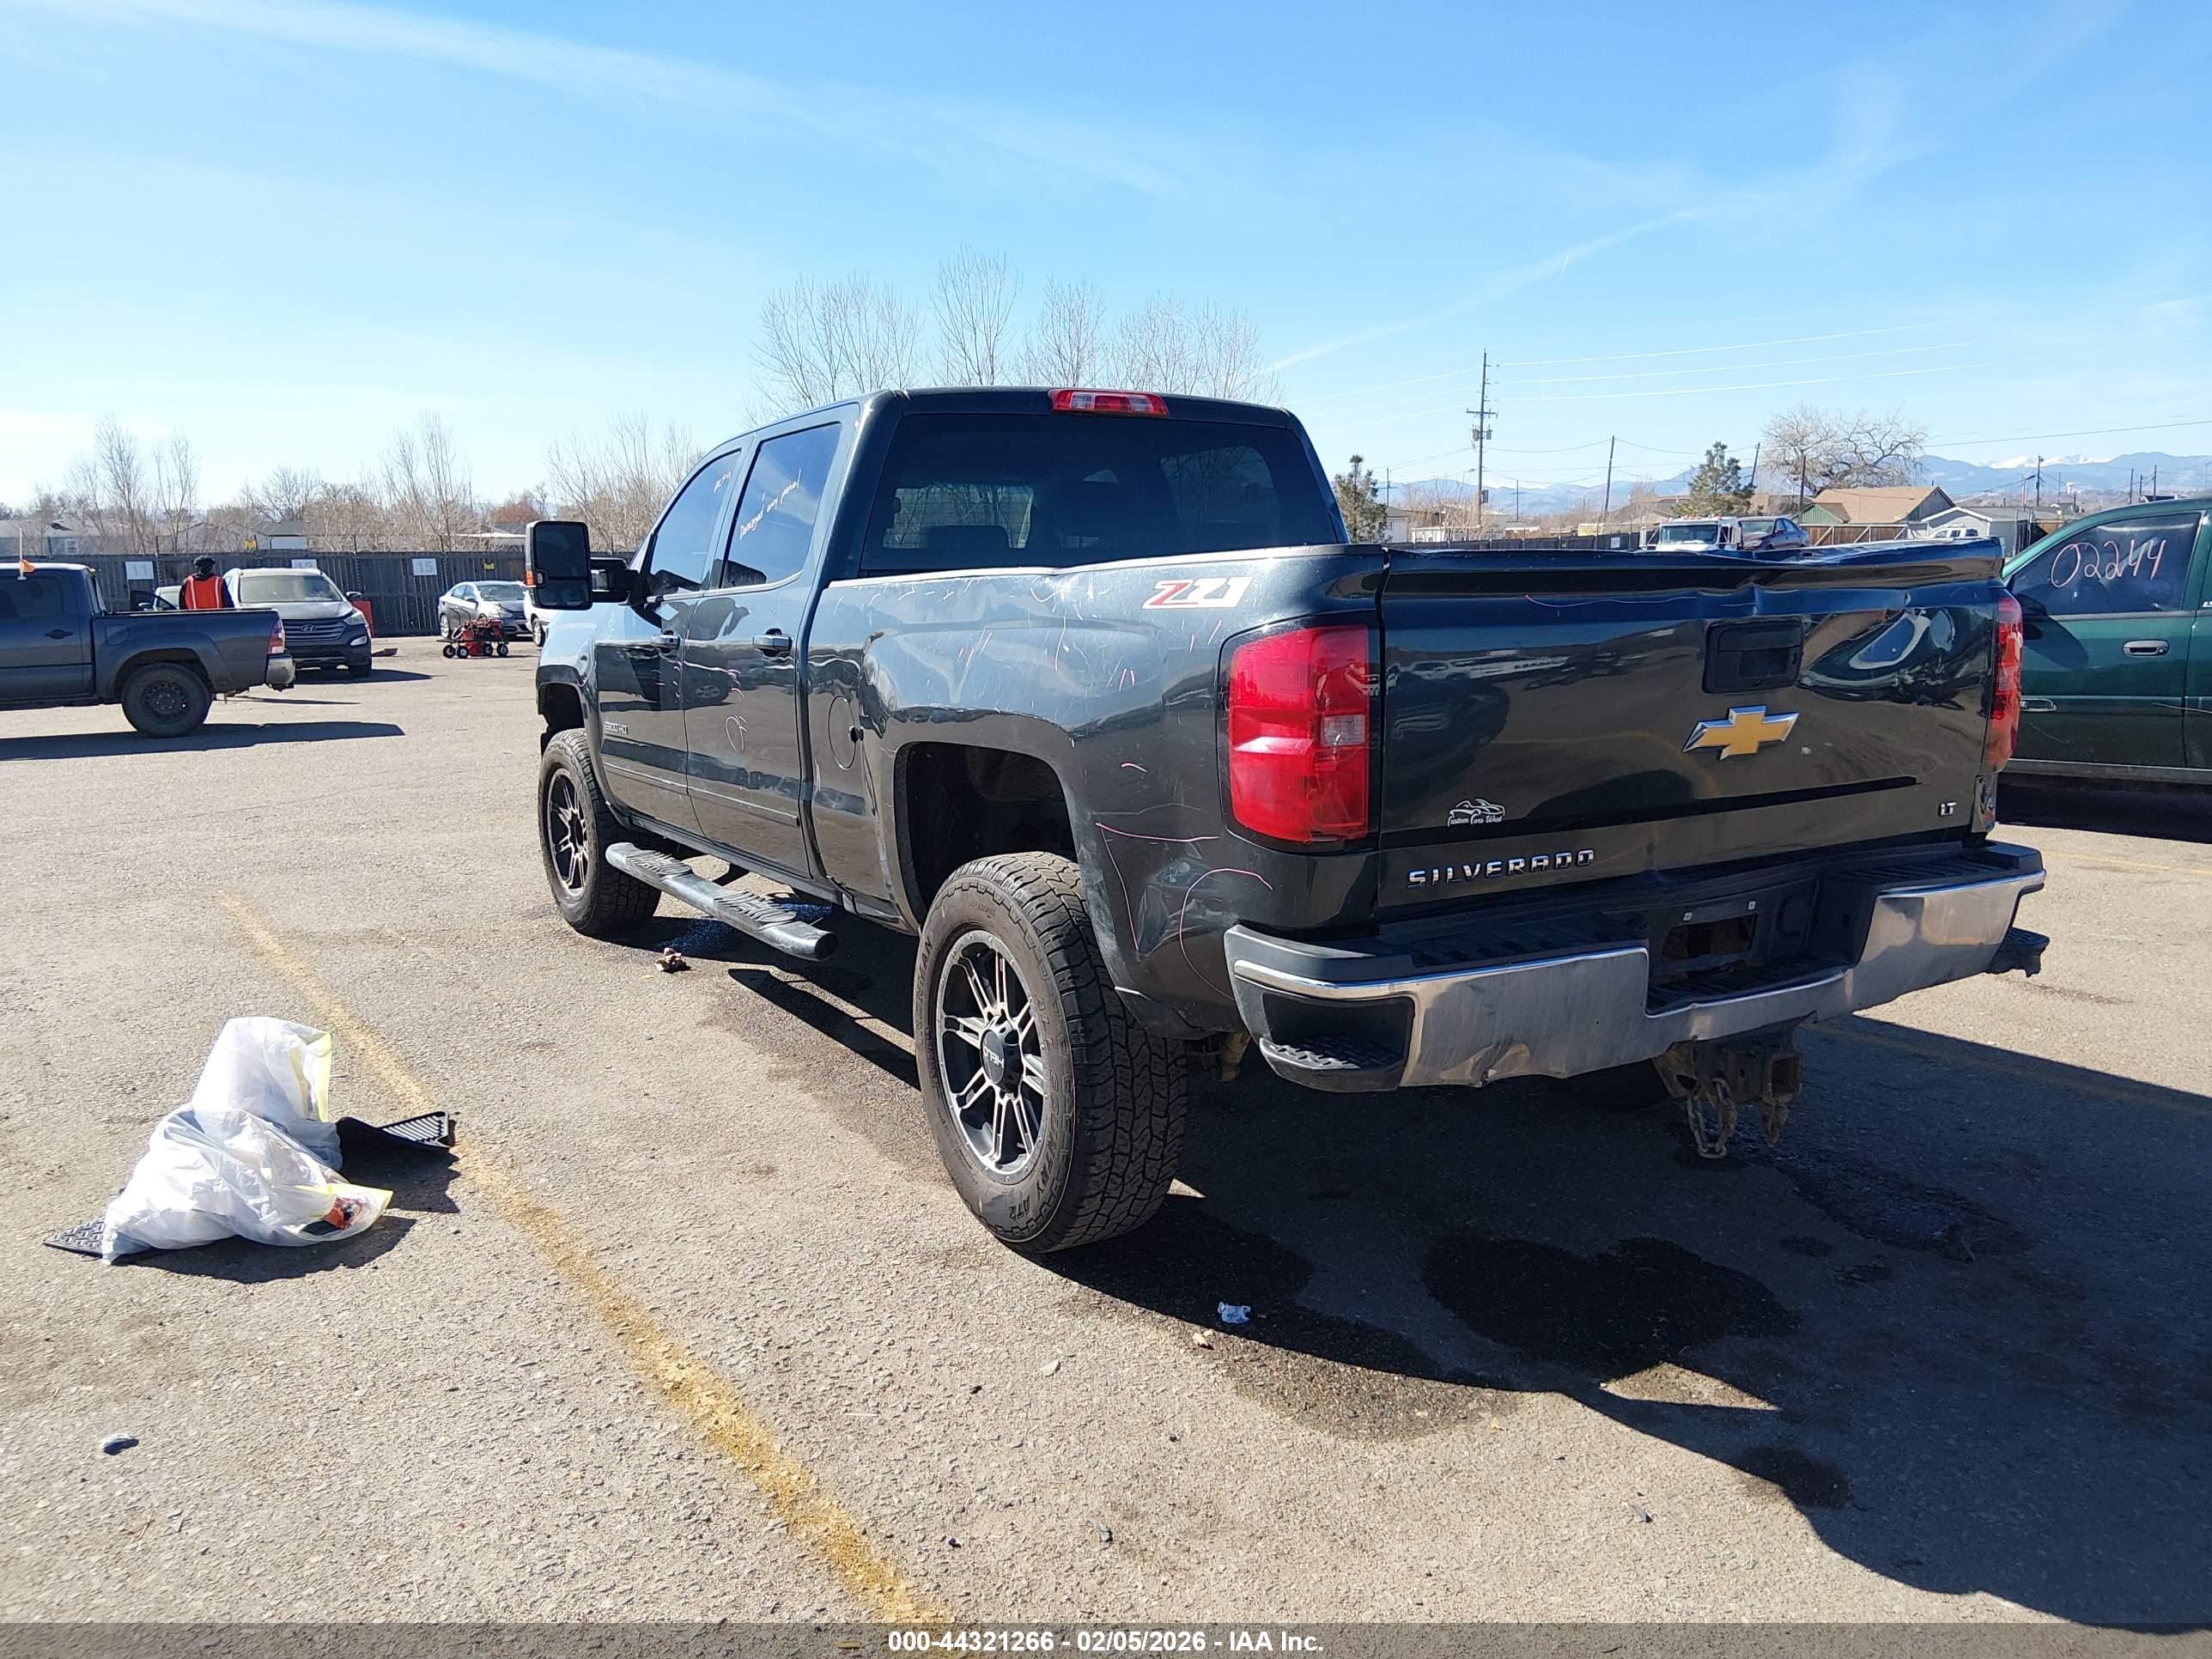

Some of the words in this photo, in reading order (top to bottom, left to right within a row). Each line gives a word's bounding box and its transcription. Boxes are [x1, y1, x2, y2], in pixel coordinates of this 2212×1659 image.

[416, 560, 434, 573] 15
[2051, 538, 2167, 588] 02244
[1142, 576, 1254, 609] Z71
[1941, 802, 1957, 815] LT
[1447, 815, 1469, 827] Custom
[1407, 848, 1595, 888] SILVERADO
